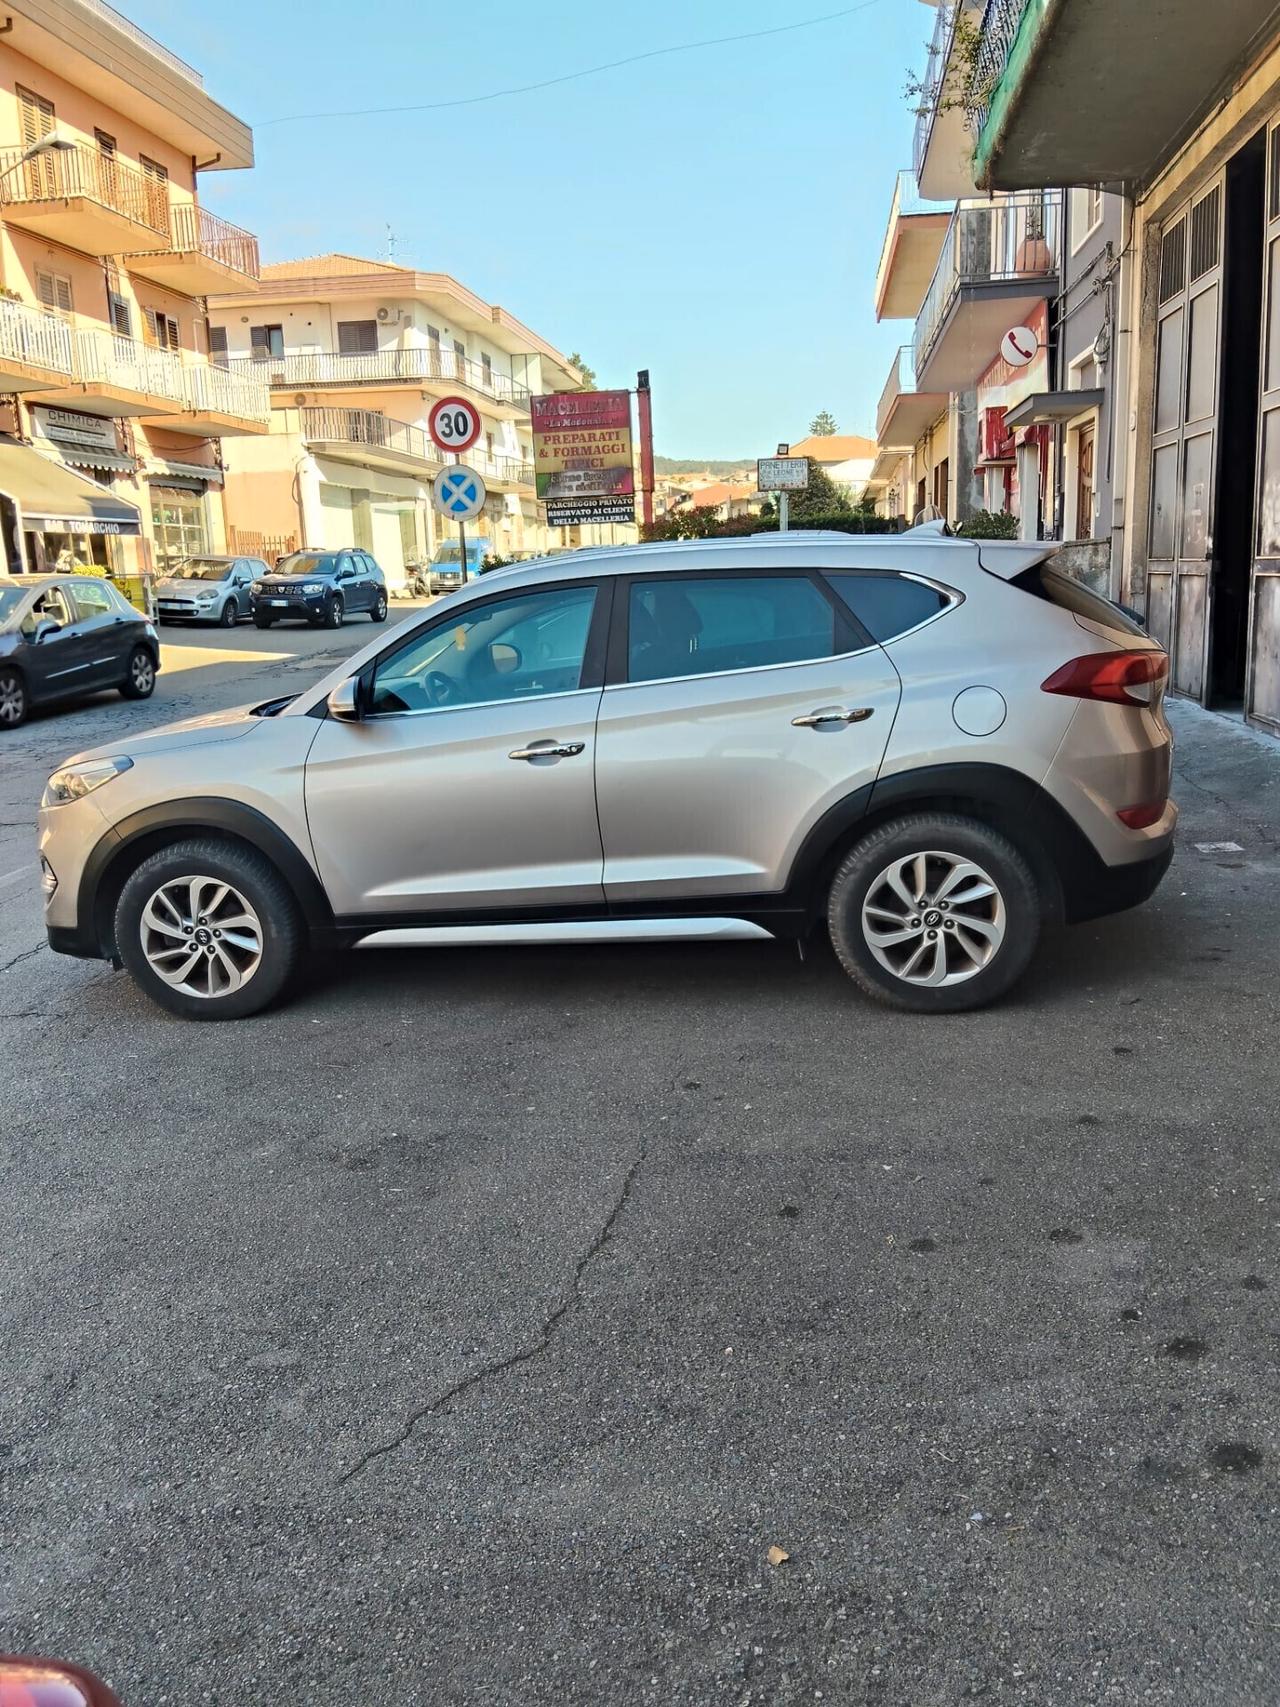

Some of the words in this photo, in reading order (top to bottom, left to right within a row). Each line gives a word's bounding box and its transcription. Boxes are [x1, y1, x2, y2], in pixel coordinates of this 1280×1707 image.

[49, 410, 102, 428] CHIMICA
[440, 411, 468, 438] 30
[543, 431, 621, 445] PREPARATI
[539, 448, 548, 458] &
[553, 443, 627, 458] FORMAGGI
[547, 501, 597, 509] PARCHEGGIO
[599, 498, 633, 506] PRIVATO
[548, 509, 591, 517] RISERVATO
[603, 506, 634, 514] CLIENTI
[69, 520, 120, 534] TOMARCHIO
[553, 518, 579, 526] DELLA
[580, 514, 630, 524] MACELLERIA
